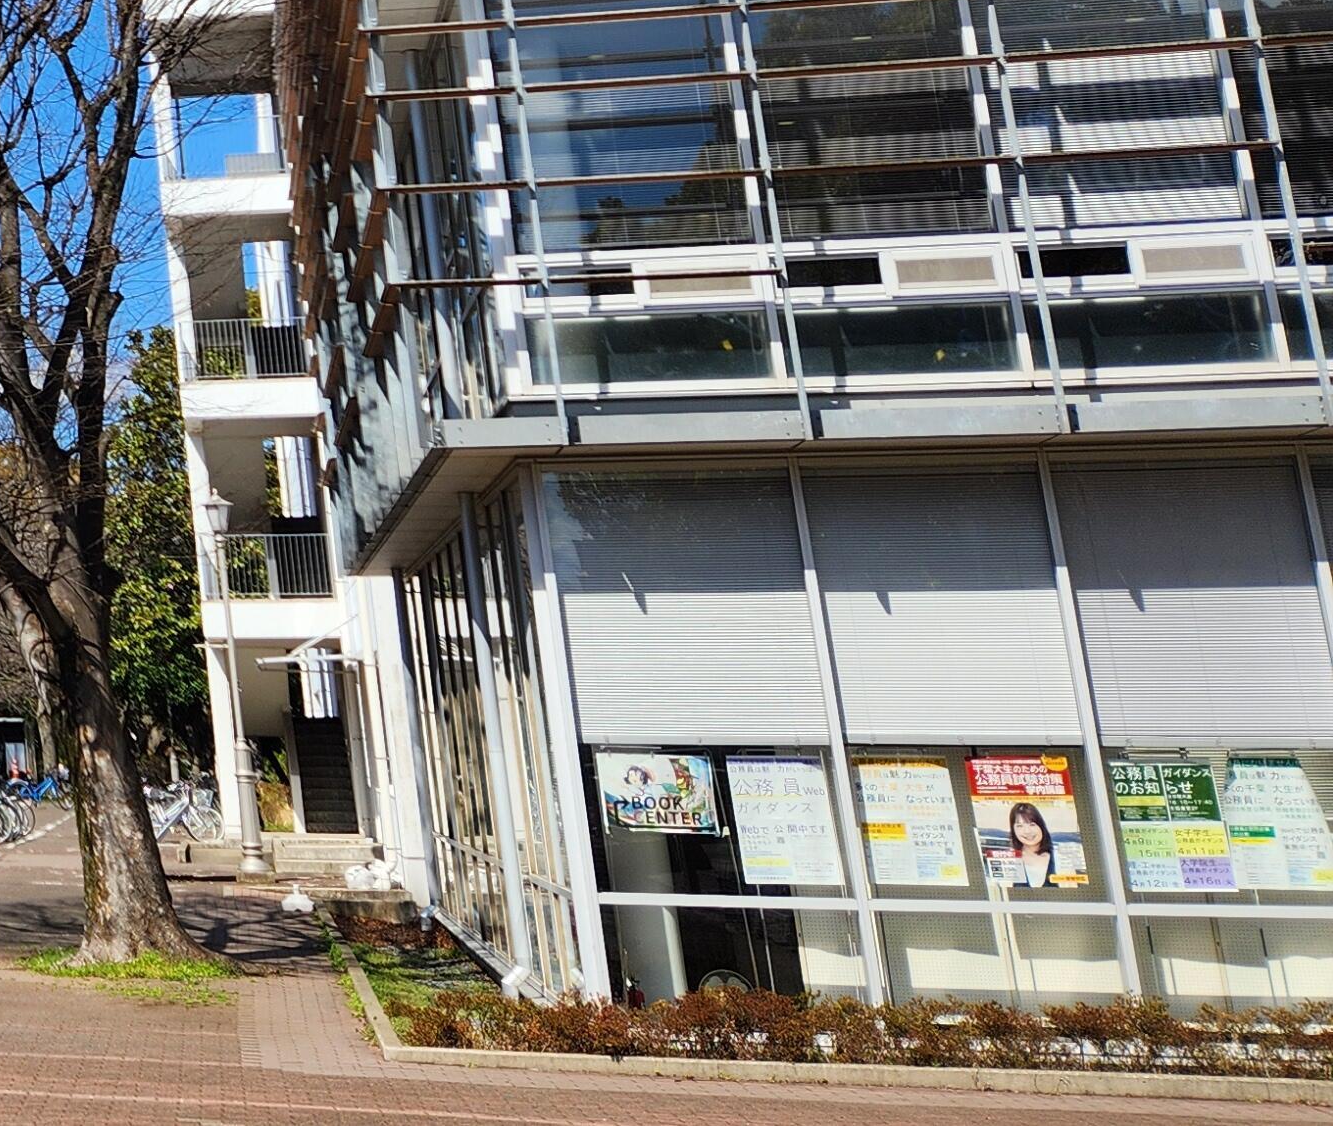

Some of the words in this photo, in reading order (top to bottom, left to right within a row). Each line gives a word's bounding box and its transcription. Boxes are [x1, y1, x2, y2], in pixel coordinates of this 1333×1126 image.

[631, 795, 685, 811] BOOK
[736, 801, 814, 814] ガイダンス
[634, 810, 704, 826] CENTER
